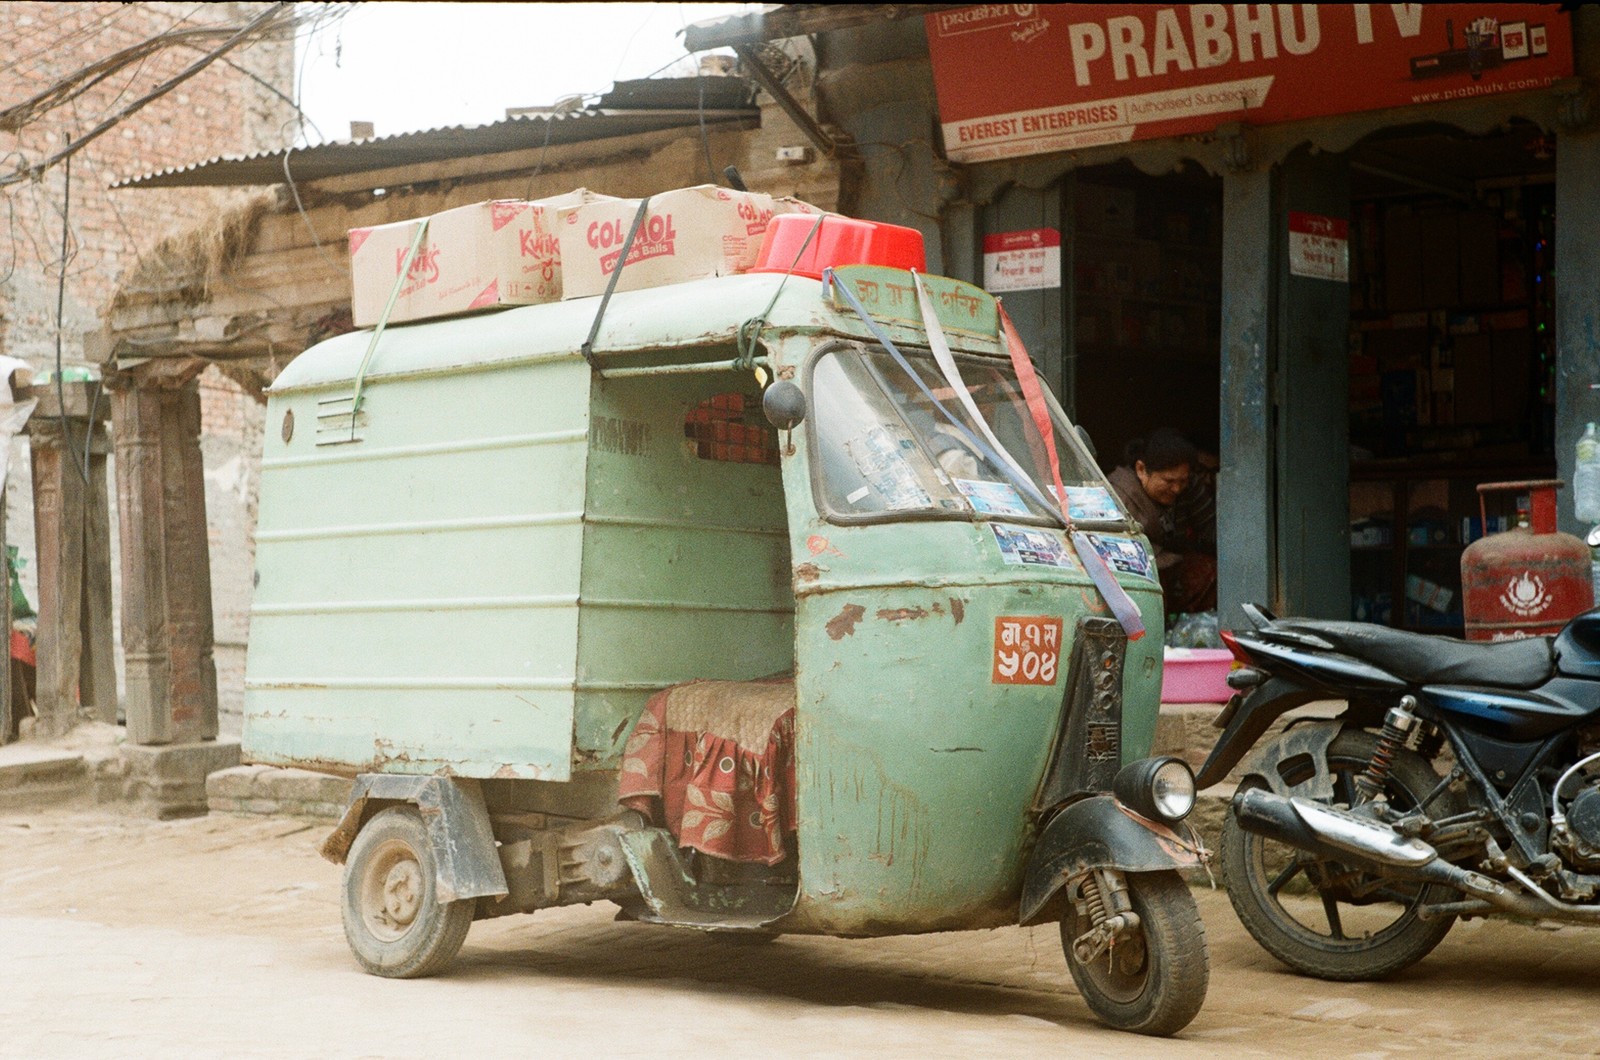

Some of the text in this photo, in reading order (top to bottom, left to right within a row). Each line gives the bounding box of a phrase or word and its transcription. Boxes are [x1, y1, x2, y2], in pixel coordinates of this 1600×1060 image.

[1068, 4, 1321, 87] PRABHU
[958, 104, 1119, 143] EVEREST ENTERPRISES
[587, 219, 624, 249] GOL
[604, 243, 669, 271] Chse Balls
[998, 650, 1056, 681] ५०४
